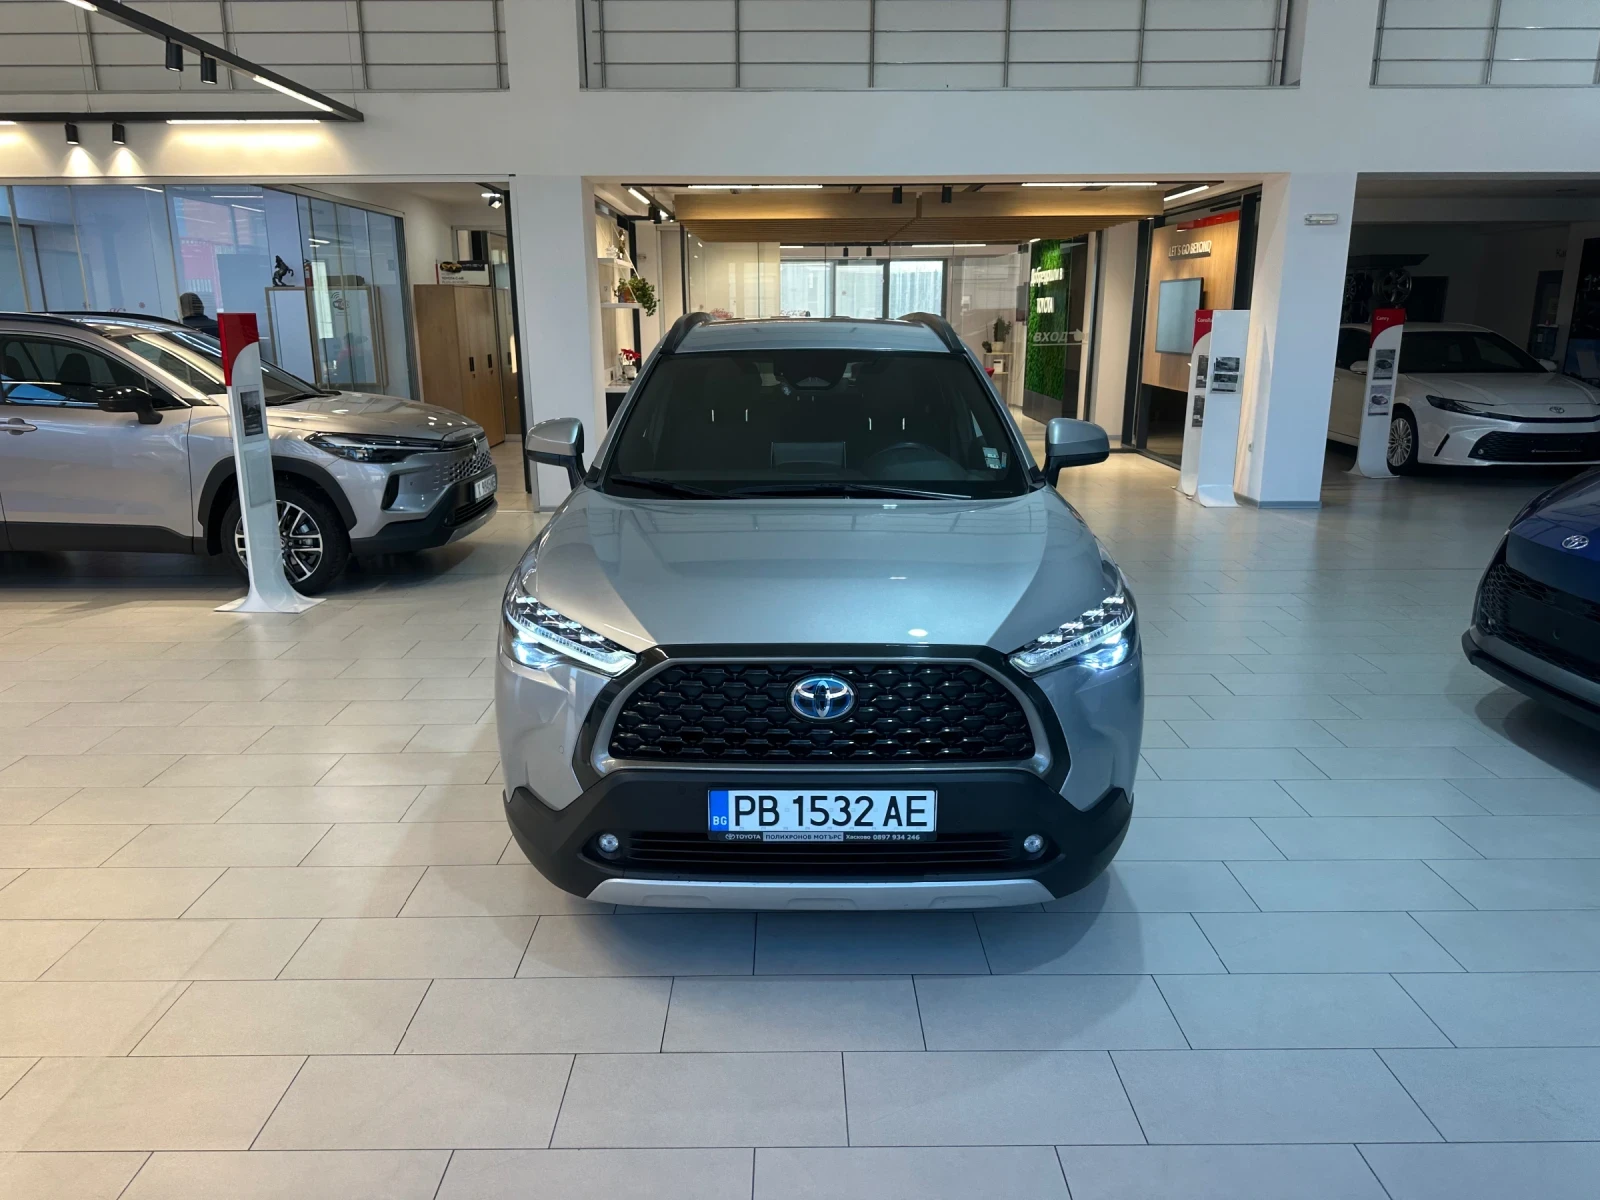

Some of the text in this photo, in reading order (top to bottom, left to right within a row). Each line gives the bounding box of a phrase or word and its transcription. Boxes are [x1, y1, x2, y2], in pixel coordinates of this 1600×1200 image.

[1181, 243, 1190, 255] GO
[1190, 240, 1212, 254] BEYOND
[1033, 331, 1068, 342] ВХОД
[734, 795, 928, 827] PB 1532 AE
[712, 815, 728, 826] BG
[735, 833, 761, 841] TOYOTA
[765, 833, 842, 841] ПОЛИХРОНОВ МОТЪРС
[872, 833, 890, 841] 0897
[891, 833, 906, 841] 934
[906, 833, 920, 841] 246
